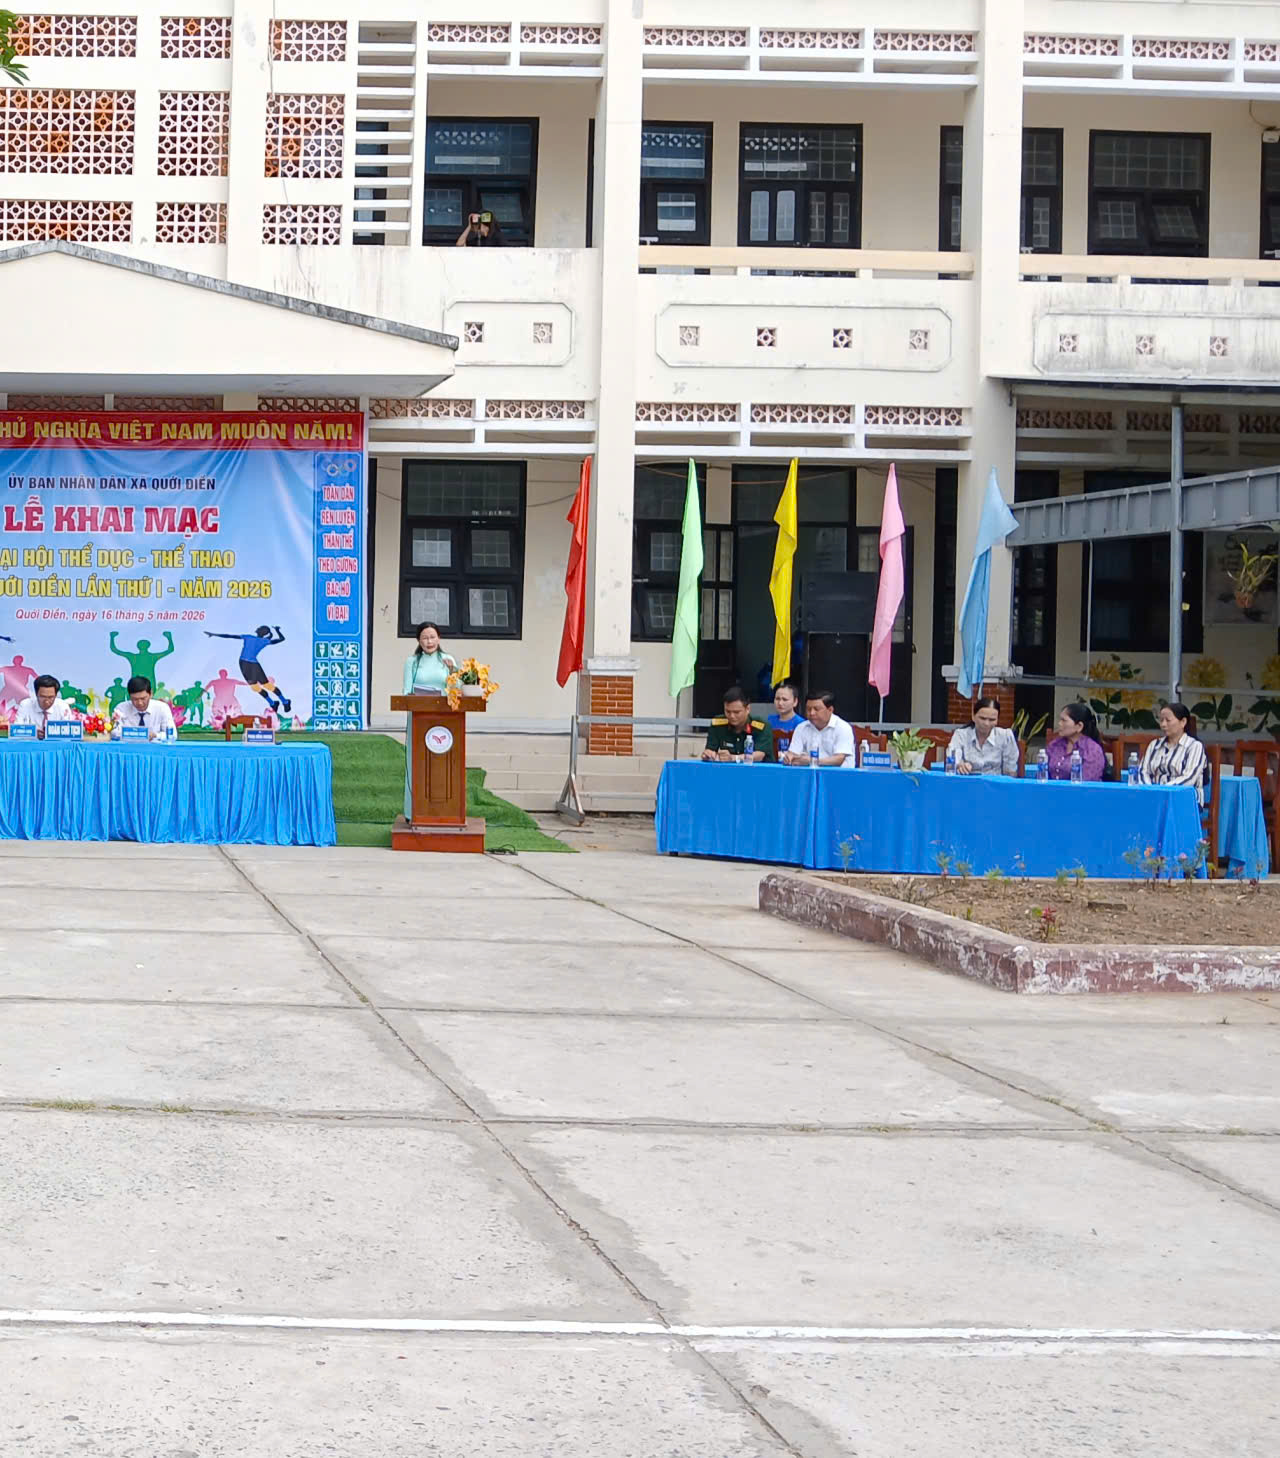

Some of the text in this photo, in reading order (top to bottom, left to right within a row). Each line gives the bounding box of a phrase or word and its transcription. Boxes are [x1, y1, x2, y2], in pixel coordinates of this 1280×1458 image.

[34, 419, 101, 438] NGHĨA
[108, 420, 154, 443] VIỆT
[161, 422, 213, 440] NAM
[220, 420, 286, 440] MUÔN
[293, 420, 353, 441] NĂM!
[8, 473, 24, 489] ỦY
[29, 477, 55, 489] BAN
[60, 475, 96, 489] NHÂN
[100, 475, 126, 489] DÂN
[152, 475, 181, 491] QUỚI
[323, 484, 339, 500] TOÀN
[4, 496, 44, 531] LỄ
[54, 506, 134, 532] KHAI
[145, 507, 218, 537] MẠC
[23, 545, 53, 570] HỘI
[59, 542, 93, 567] THỂ
[97, 549, 133, 571] DỤC
[151, 543, 185, 568] THỂ
[189, 550, 235, 568] THAO
[319, 558, 335, 572] THEO
[76, 573, 111, 597] LẦN
[117, 576, 153, 597] THỨ
[156, 579, 162, 597] I
[180, 576, 222, 598] NĂM
[227, 580, 272, 598] 2026
[72, 609, 97, 621] ngày
[101, 610, 112, 620] 16
[115, 610, 144, 622] tháng
[148, 610, 154, 620] 5
[157, 610, 178, 620] năm
[182, 611, 205, 620] 2026
